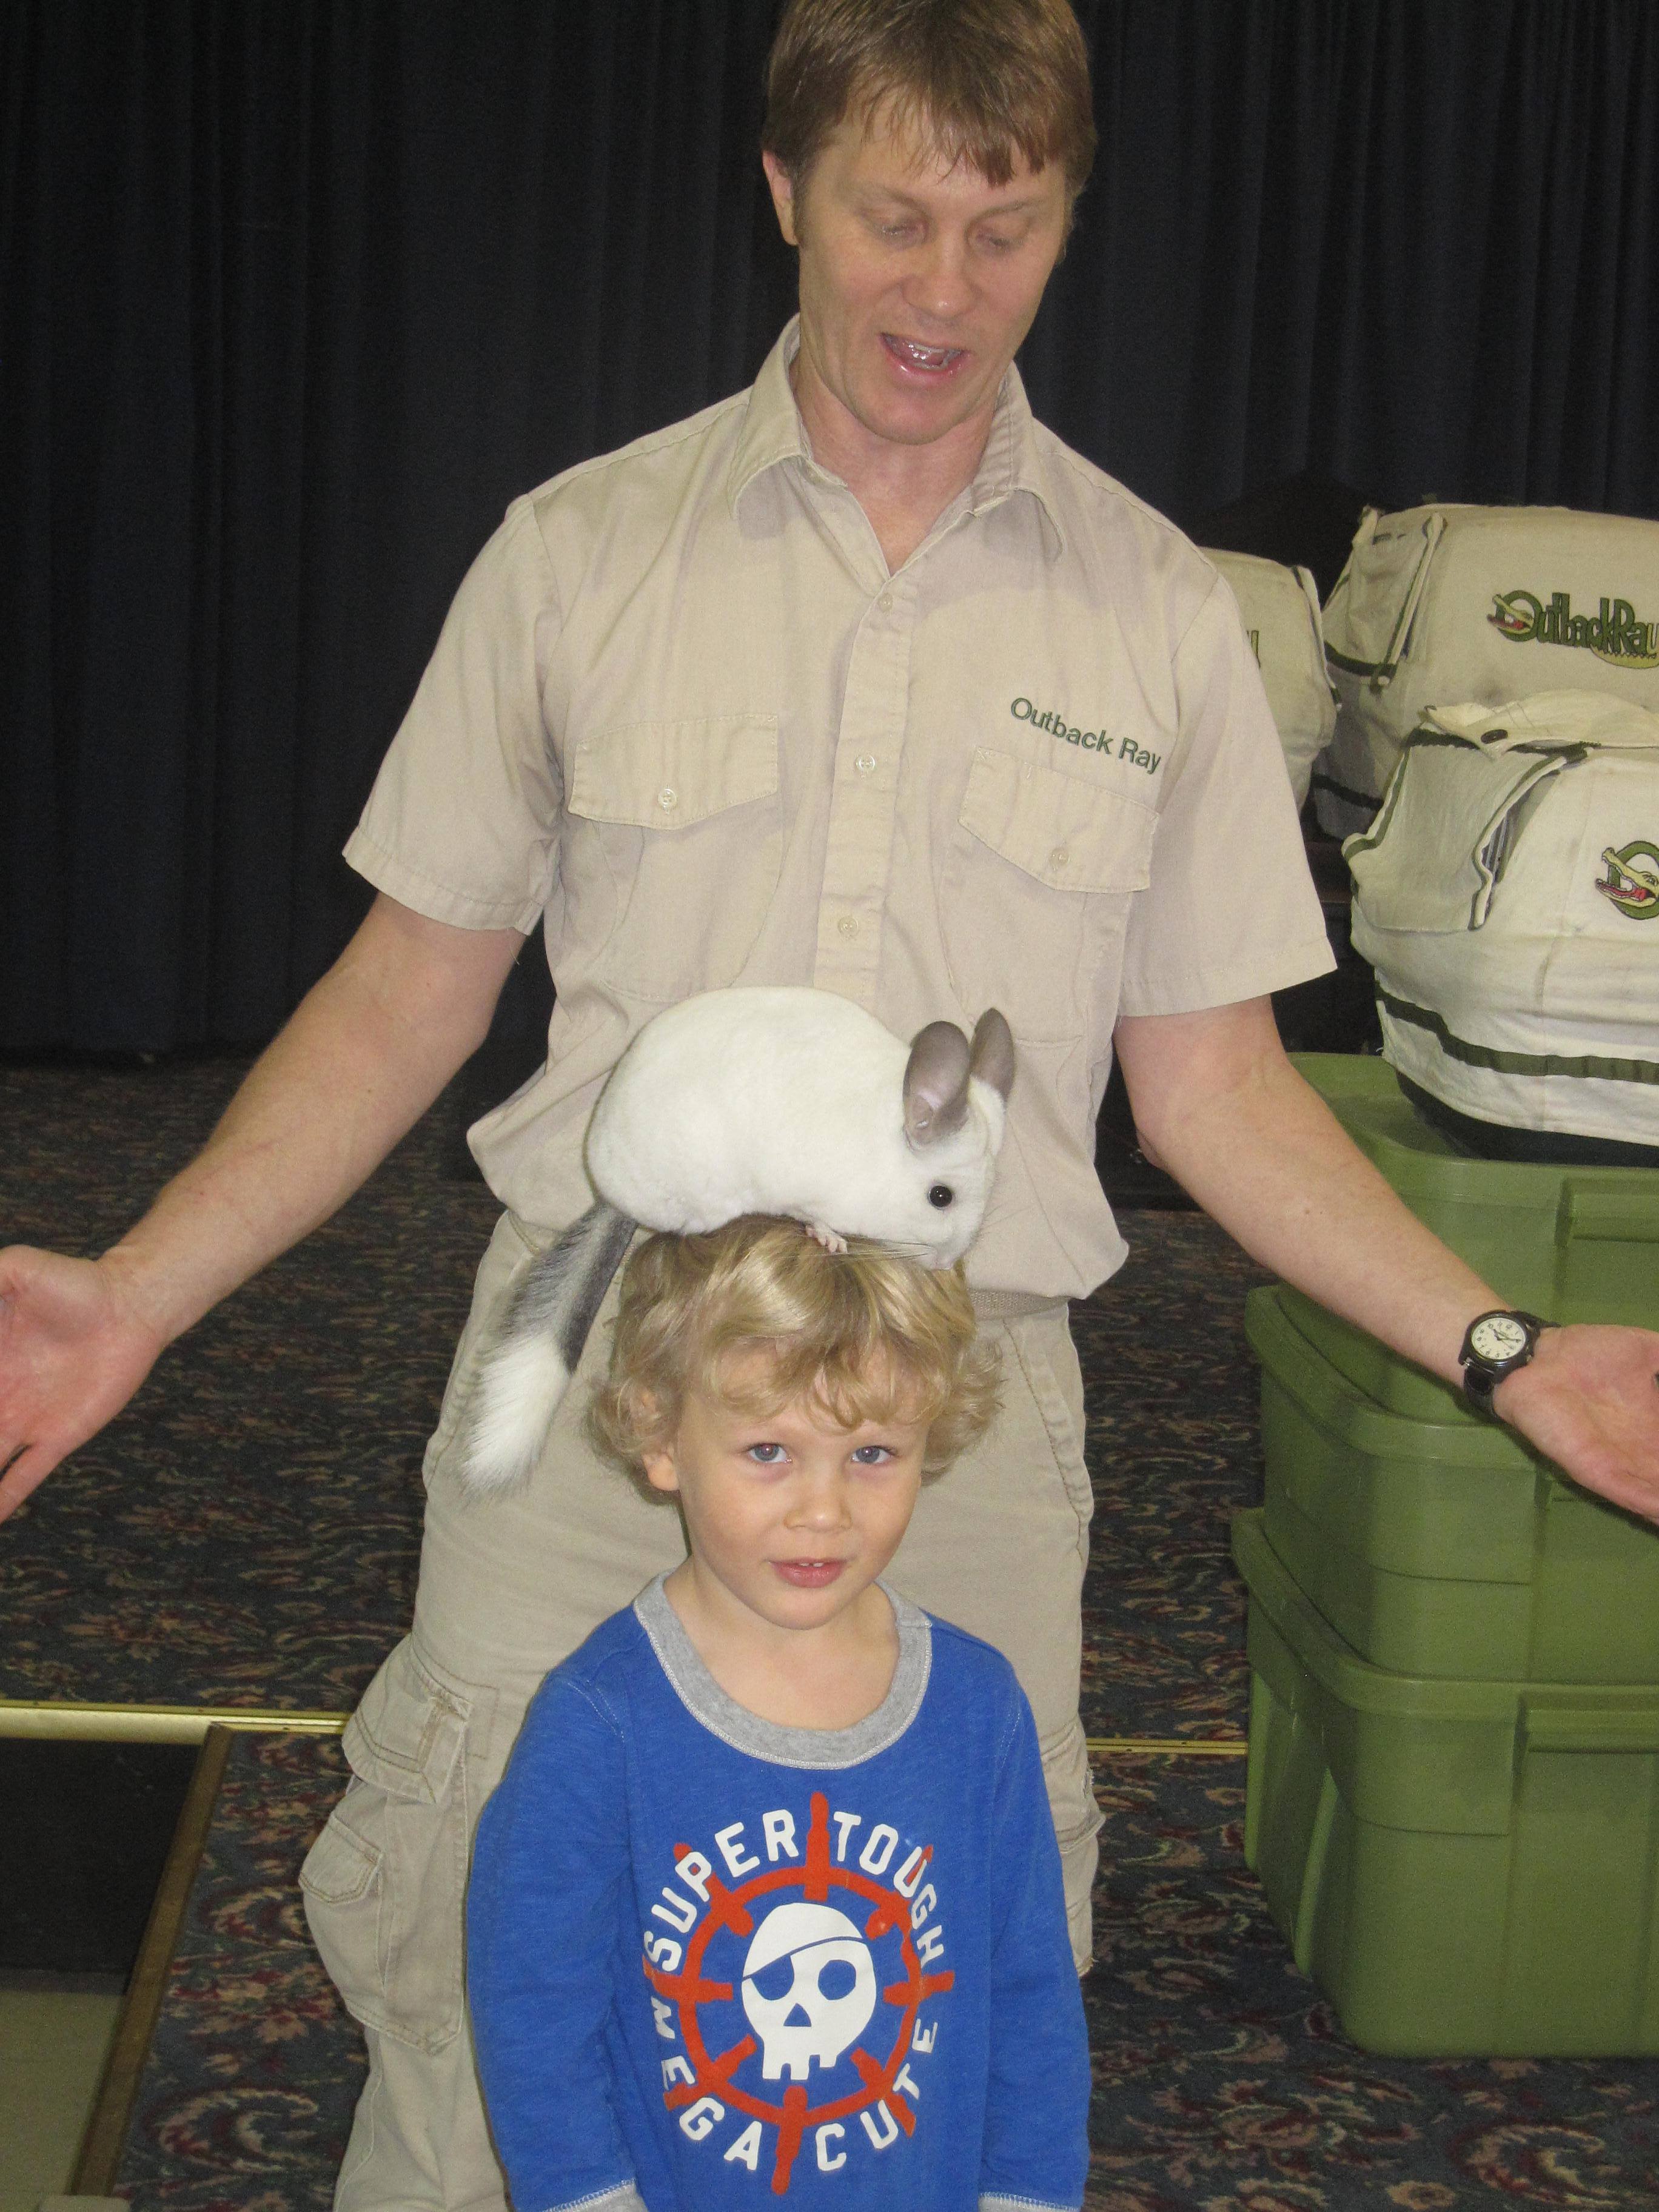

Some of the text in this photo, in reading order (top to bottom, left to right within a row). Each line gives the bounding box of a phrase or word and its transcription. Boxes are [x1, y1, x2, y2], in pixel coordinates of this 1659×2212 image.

[1011, 697, 1162, 775] Outback Ray
[643, 1809, 944, 1972] SUPER TOUGH
[651, 1997, 939, 2172] MEGA CUTE
